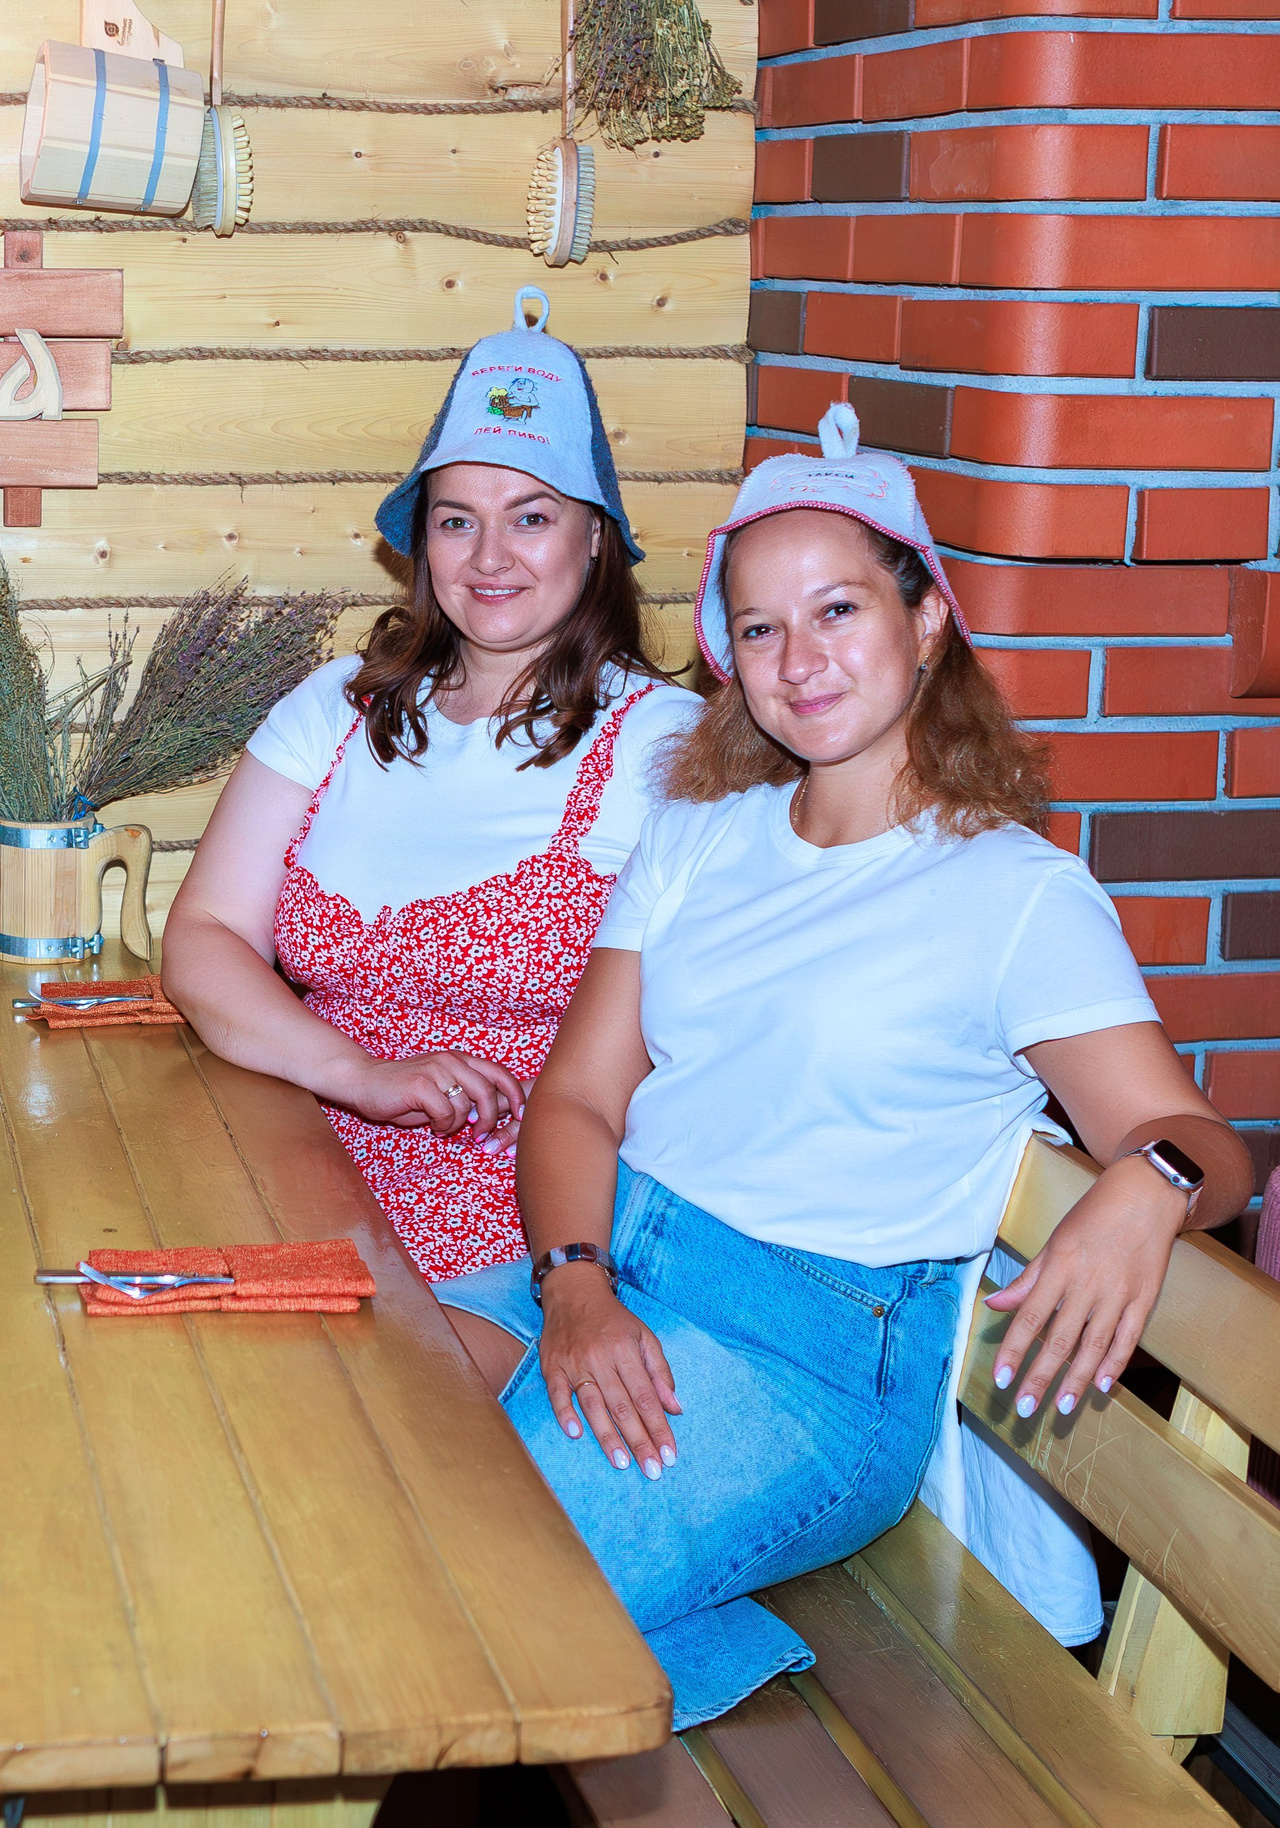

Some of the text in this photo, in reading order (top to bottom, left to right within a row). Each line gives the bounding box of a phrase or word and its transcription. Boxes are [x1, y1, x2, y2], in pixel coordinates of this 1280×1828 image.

[471, 365, 563, 382] БЕРЕГИ ВОДУ
[508, 429, 551, 446] ПИВО!
